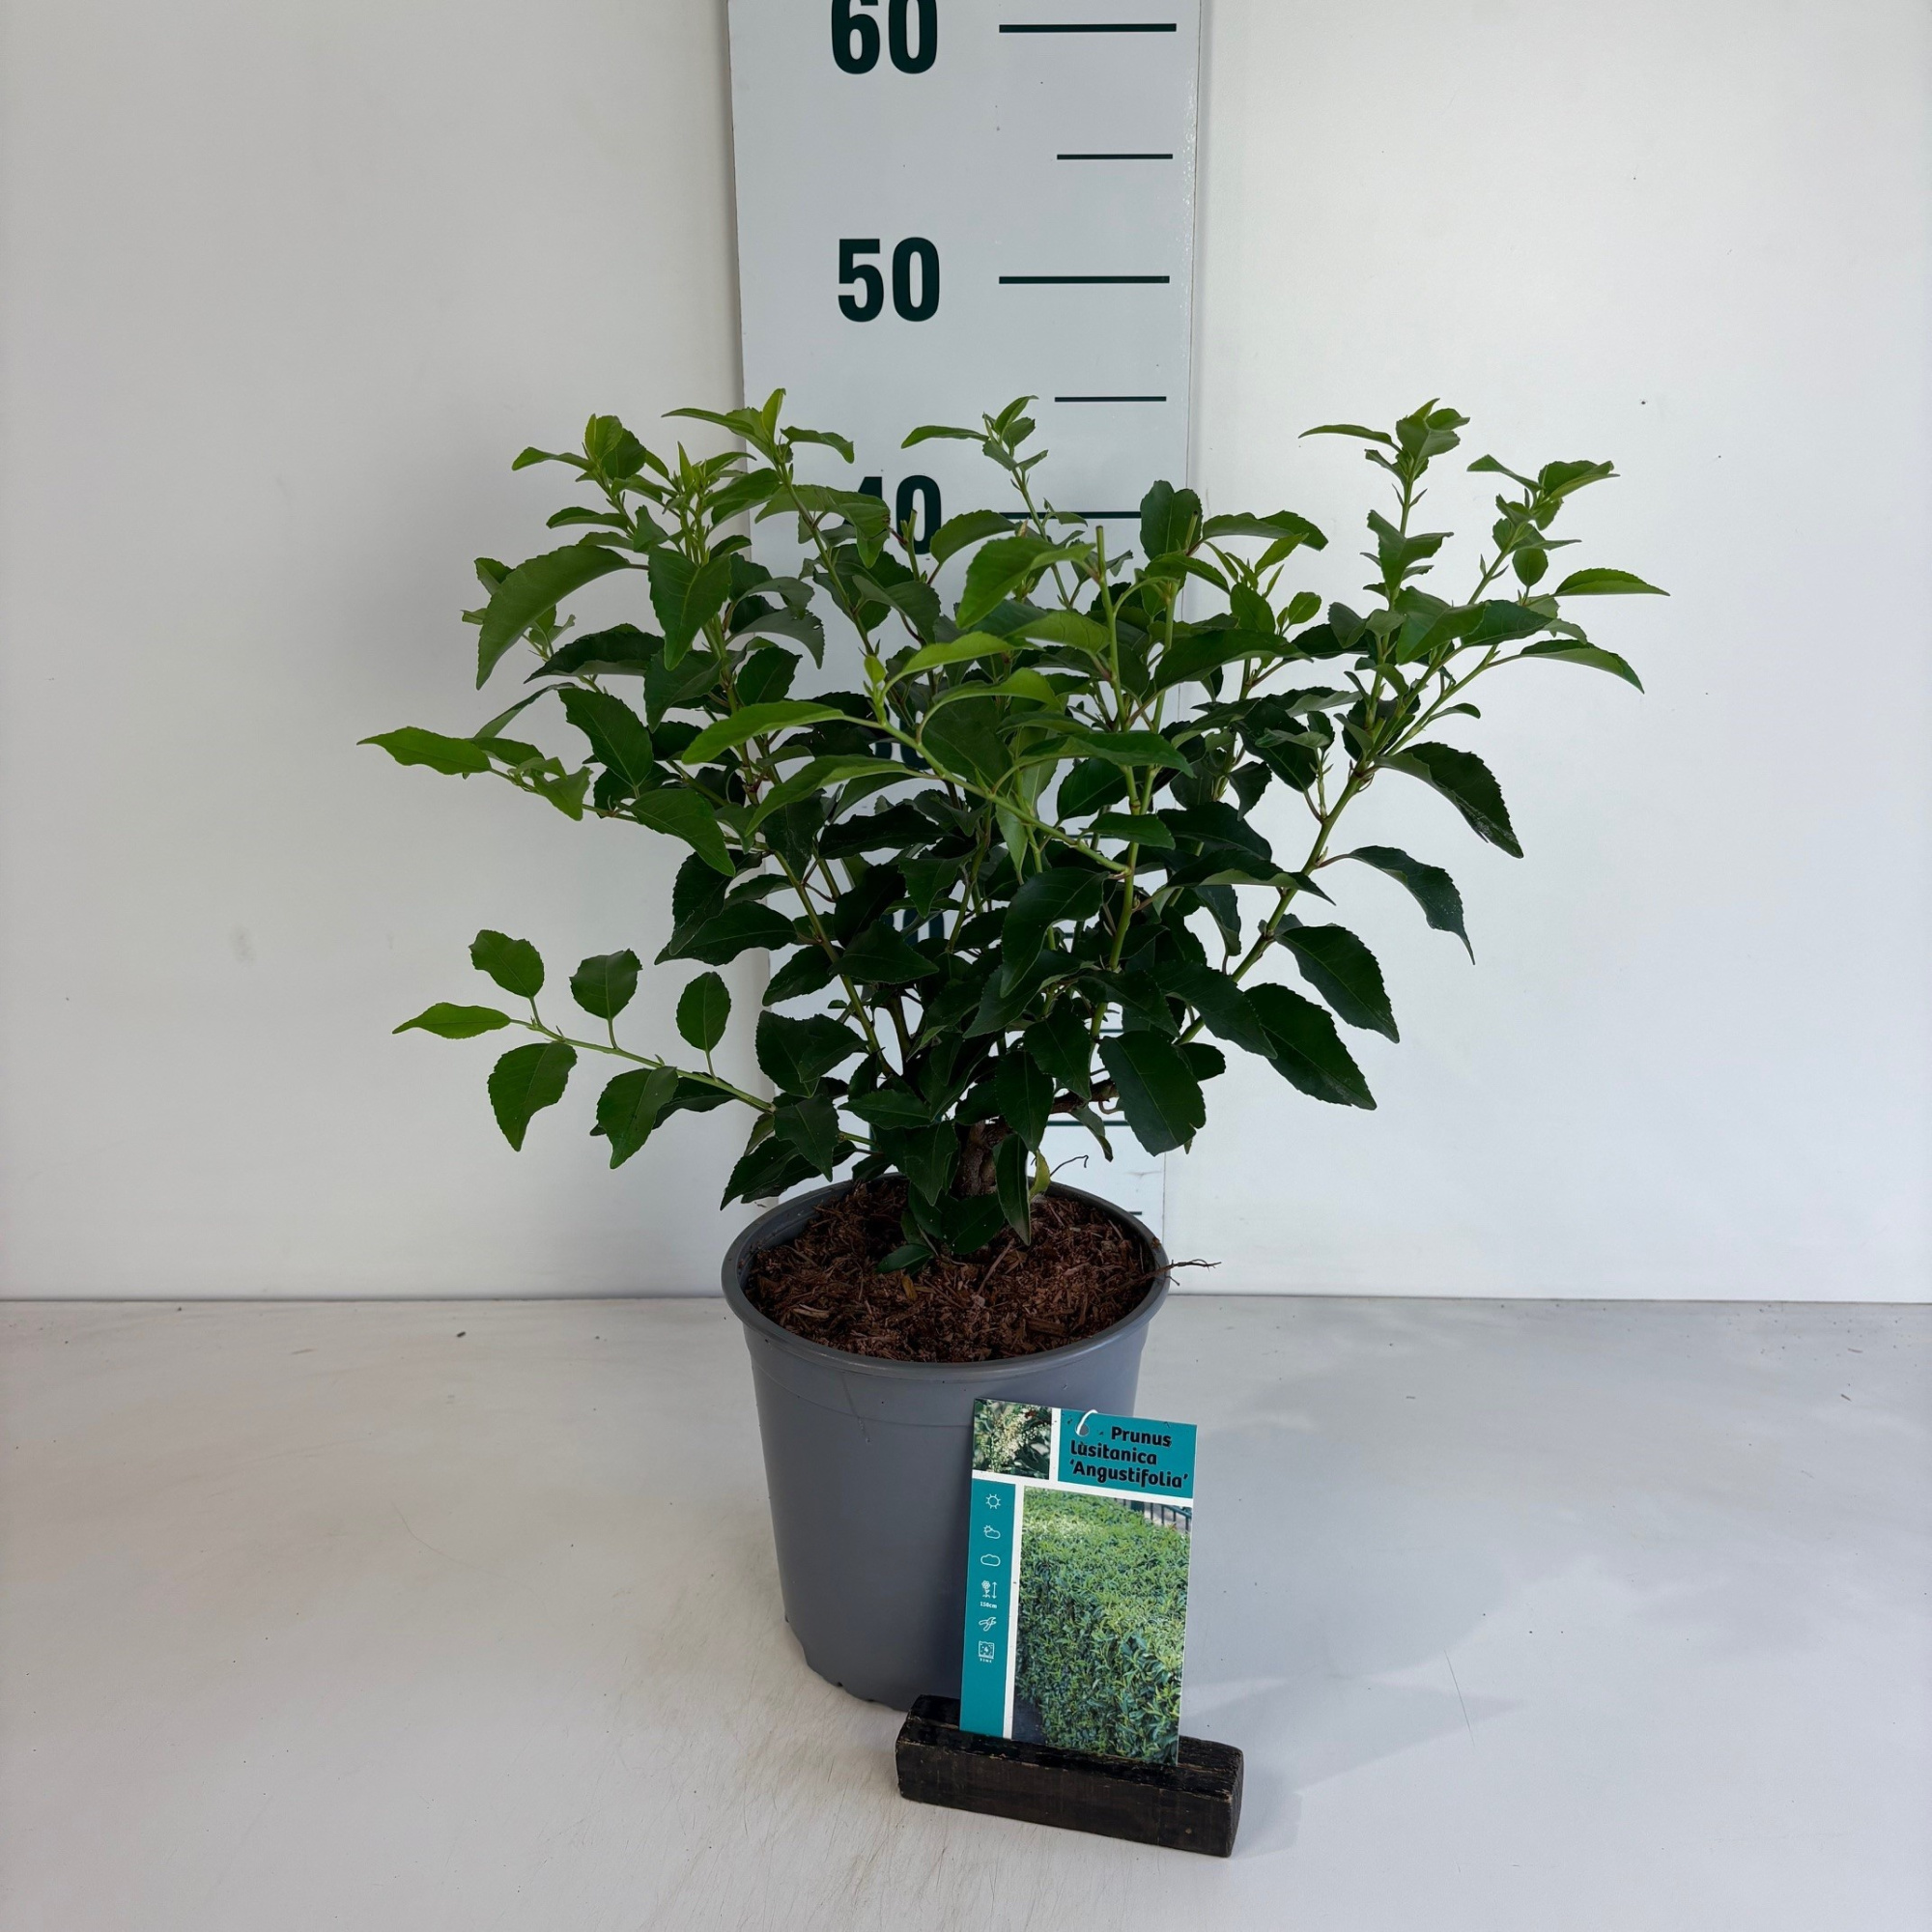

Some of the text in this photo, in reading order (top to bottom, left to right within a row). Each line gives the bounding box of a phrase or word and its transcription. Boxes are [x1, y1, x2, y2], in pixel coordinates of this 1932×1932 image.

[831, 0, 938, 74] 60
[838, 237, 940, 323] 50
[1111, 1426, 1172, 1447] Prunus
